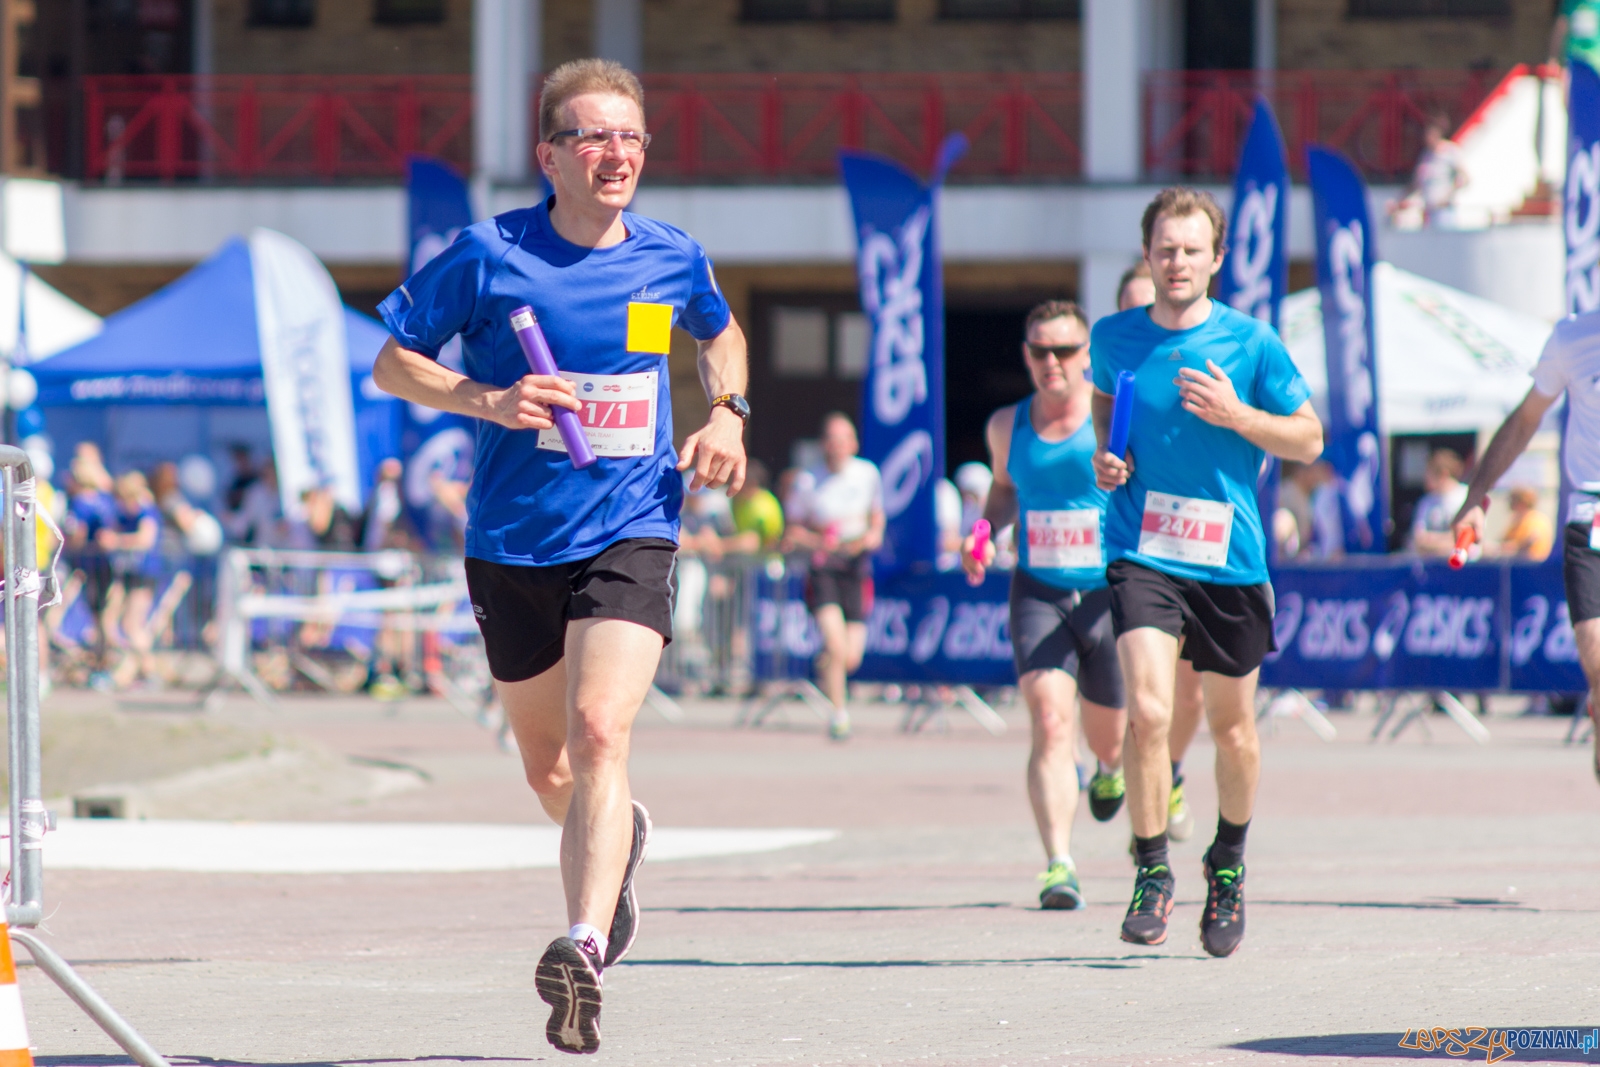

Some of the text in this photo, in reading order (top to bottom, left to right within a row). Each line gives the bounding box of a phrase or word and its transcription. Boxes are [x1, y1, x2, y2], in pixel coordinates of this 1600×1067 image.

[586, 402, 628, 427] 1/1
[1158, 514, 1207, 540] 24/1
[1299, 597, 1369, 659] asics
[1404, 593, 1493, 658] asics
